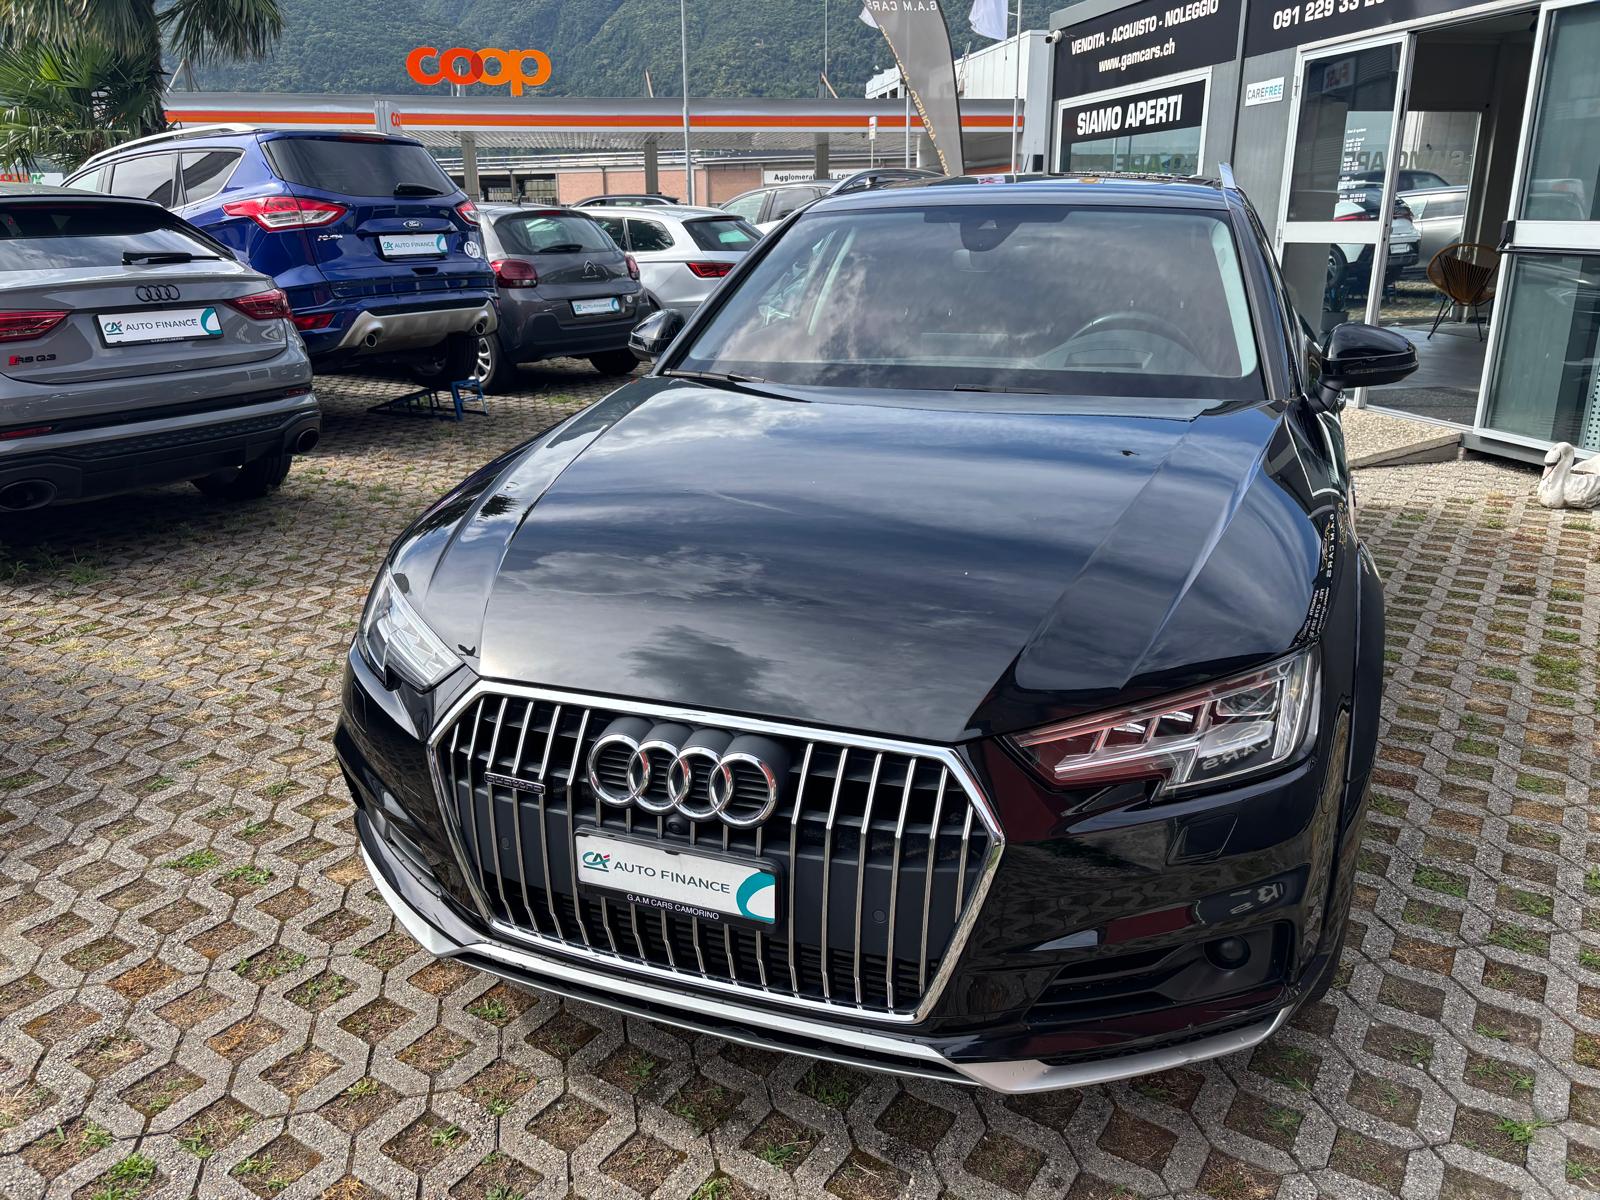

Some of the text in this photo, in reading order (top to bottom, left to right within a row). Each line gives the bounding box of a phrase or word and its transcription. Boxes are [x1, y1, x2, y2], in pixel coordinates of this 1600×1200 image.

[1071, 32, 1105, 55] VENDITA
[1111, 15, 1157, 44] ACQUISTO
[1164, 0, 1219, 27] NOLEGGIO
[1273, 5, 1300, 30] 091
[1304, 0, 1335, 22] 229
[1099, 37, 1176, 72] www.gamcars.ch
[406, 46, 552, 96] coop
[1247, 84, 1282, 100] CAREFREE
[1077, 94, 1183, 135] SIAMO APERTI
[774, 172, 816, 183] Agglomerat
[466, 242, 479, 256] CH
[125, 321, 153, 331] AUTO
[155, 318, 198, 329] FINANCE
[614, 861, 656, 877] AUTO
[661, 870, 731, 894] FINANCE
[627, 893, 720, 920] G.A.M CARS CAMORINO
